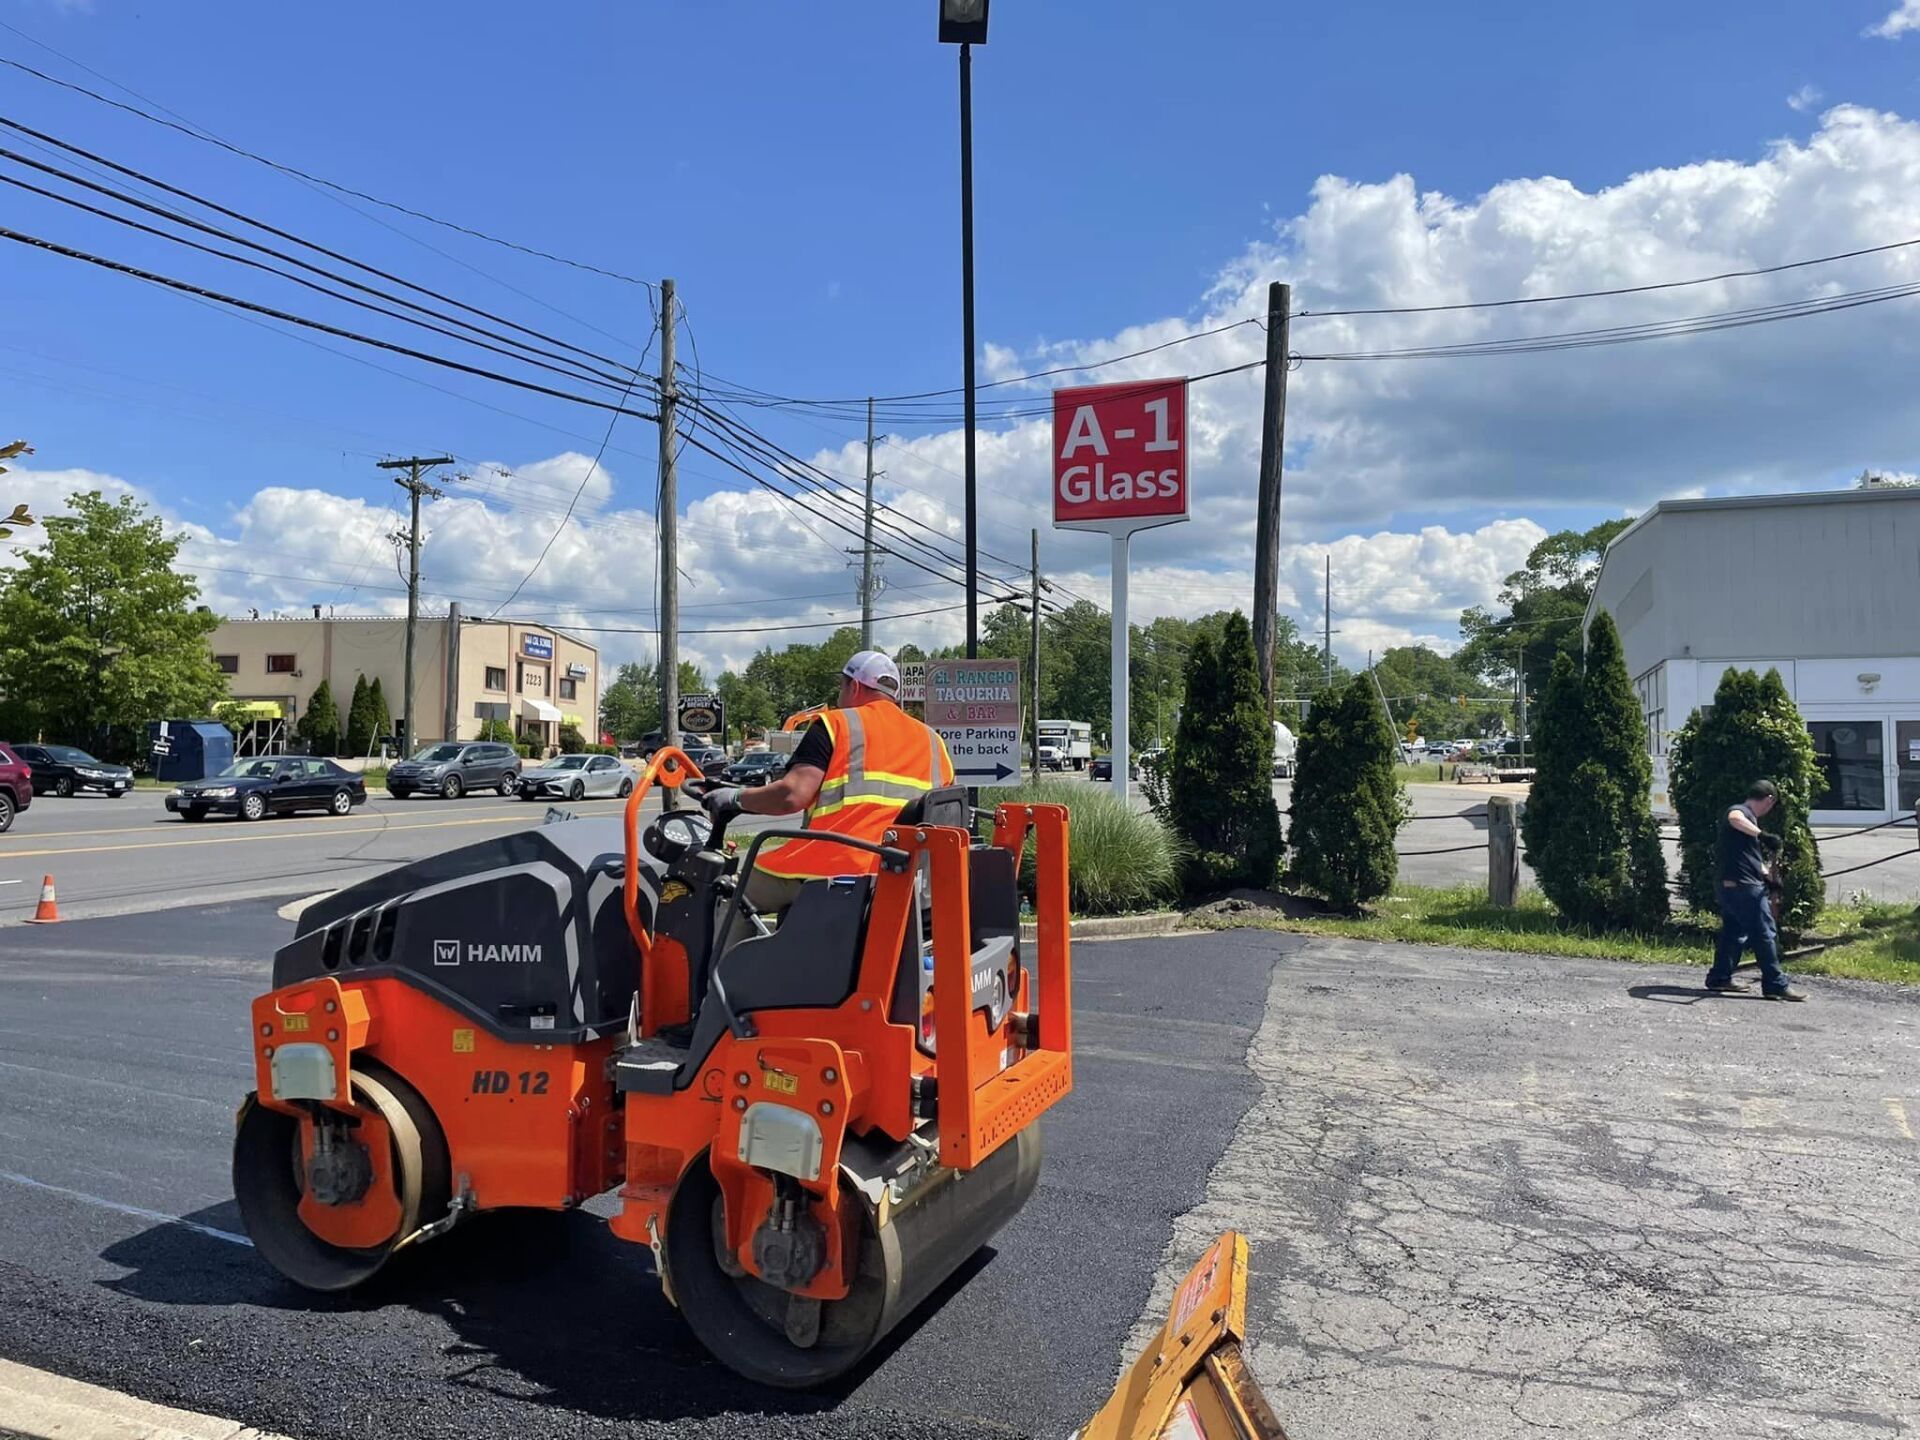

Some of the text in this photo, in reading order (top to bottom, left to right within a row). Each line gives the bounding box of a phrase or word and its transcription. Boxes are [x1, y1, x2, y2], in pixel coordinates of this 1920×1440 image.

[1060, 397, 1179, 459] A-1
[1060, 463, 1179, 503] Glass
[934, 671, 1014, 684] EL RANCHO
[936, 687, 1011, 702] TAQUERIA
[947, 707, 997, 720] & BAR
[936, 728, 1016, 741] ore Parking
[953, 744, 1009, 755] the back
[467, 945, 542, 962] HAMM
[472, 1071, 549, 1094] HD 12
